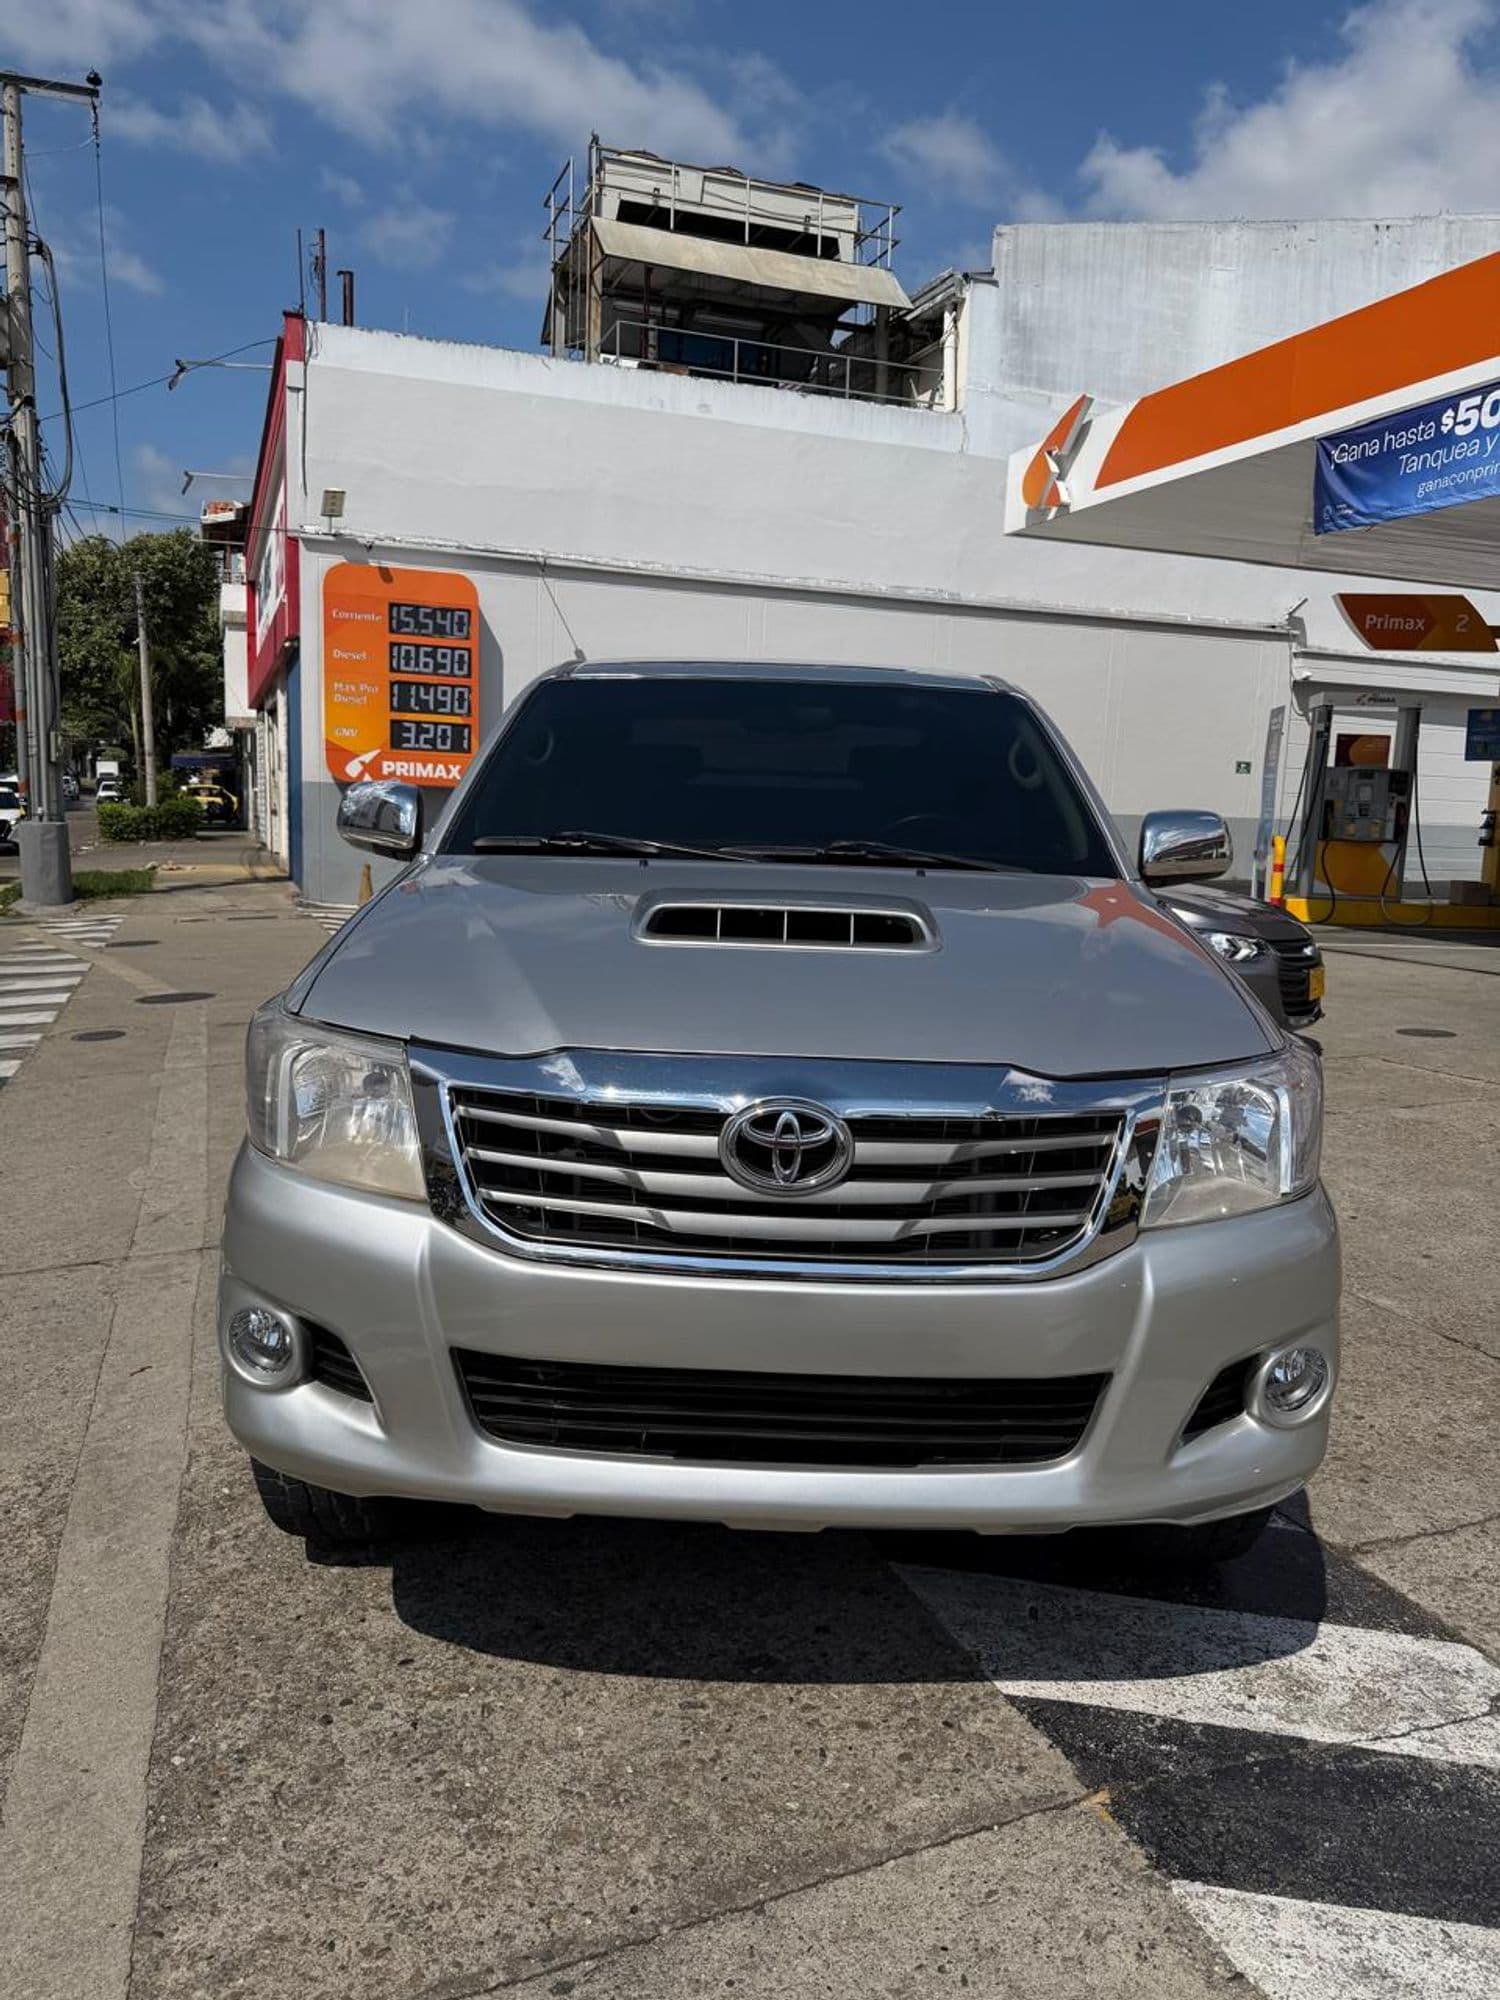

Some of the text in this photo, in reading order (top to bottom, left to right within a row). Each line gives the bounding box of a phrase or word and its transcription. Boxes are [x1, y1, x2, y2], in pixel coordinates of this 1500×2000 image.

[1331, 440, 1380, 470] ¡Gana
[1383, 421, 1436, 453] hasta
[1399, 434, 1499, 476] Tanquea y
[332, 609, 382, 623] Corriente
[391, 606, 469, 637] 15.540
[1365, 615, 1469, 632] Primax 2
[332, 648, 367, 660] Diesel
[391, 644, 469, 676] 10.690
[391, 684, 469, 715] 11.490
[401, 723, 469, 749] 3.201
[382, 761, 462, 780] PRIMAX
